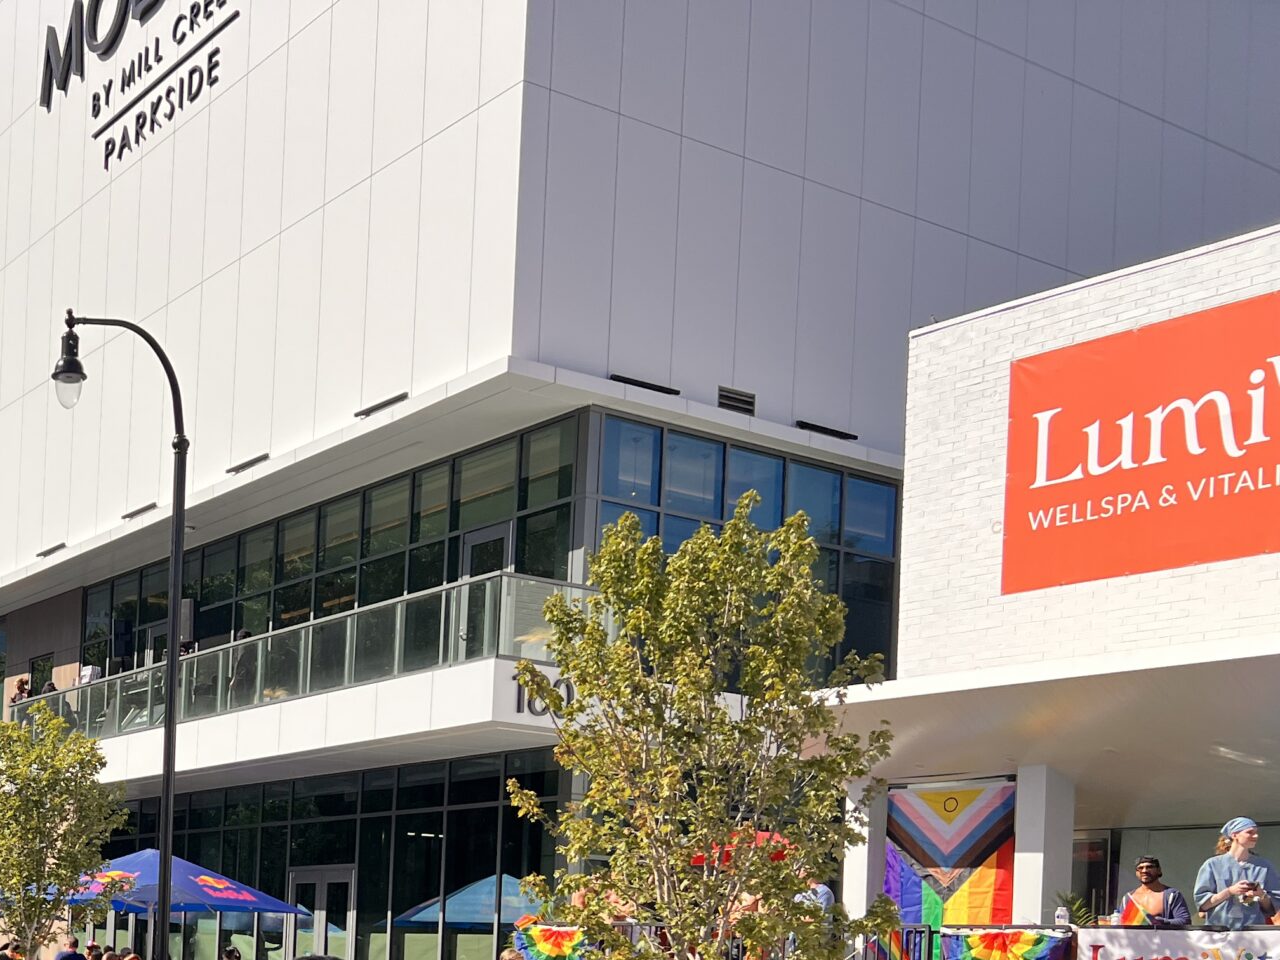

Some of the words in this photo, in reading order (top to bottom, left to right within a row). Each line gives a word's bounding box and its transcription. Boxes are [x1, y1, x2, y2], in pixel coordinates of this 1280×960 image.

[91, 79, 113, 119] BY
[120, 37, 163, 95] MILL
[103, 46, 220, 171] PARKSIDE
[1029, 355, 1280, 489] Lumi
[1028, 490, 1150, 530] WELLSPA
[1158, 485, 1178, 508] &
